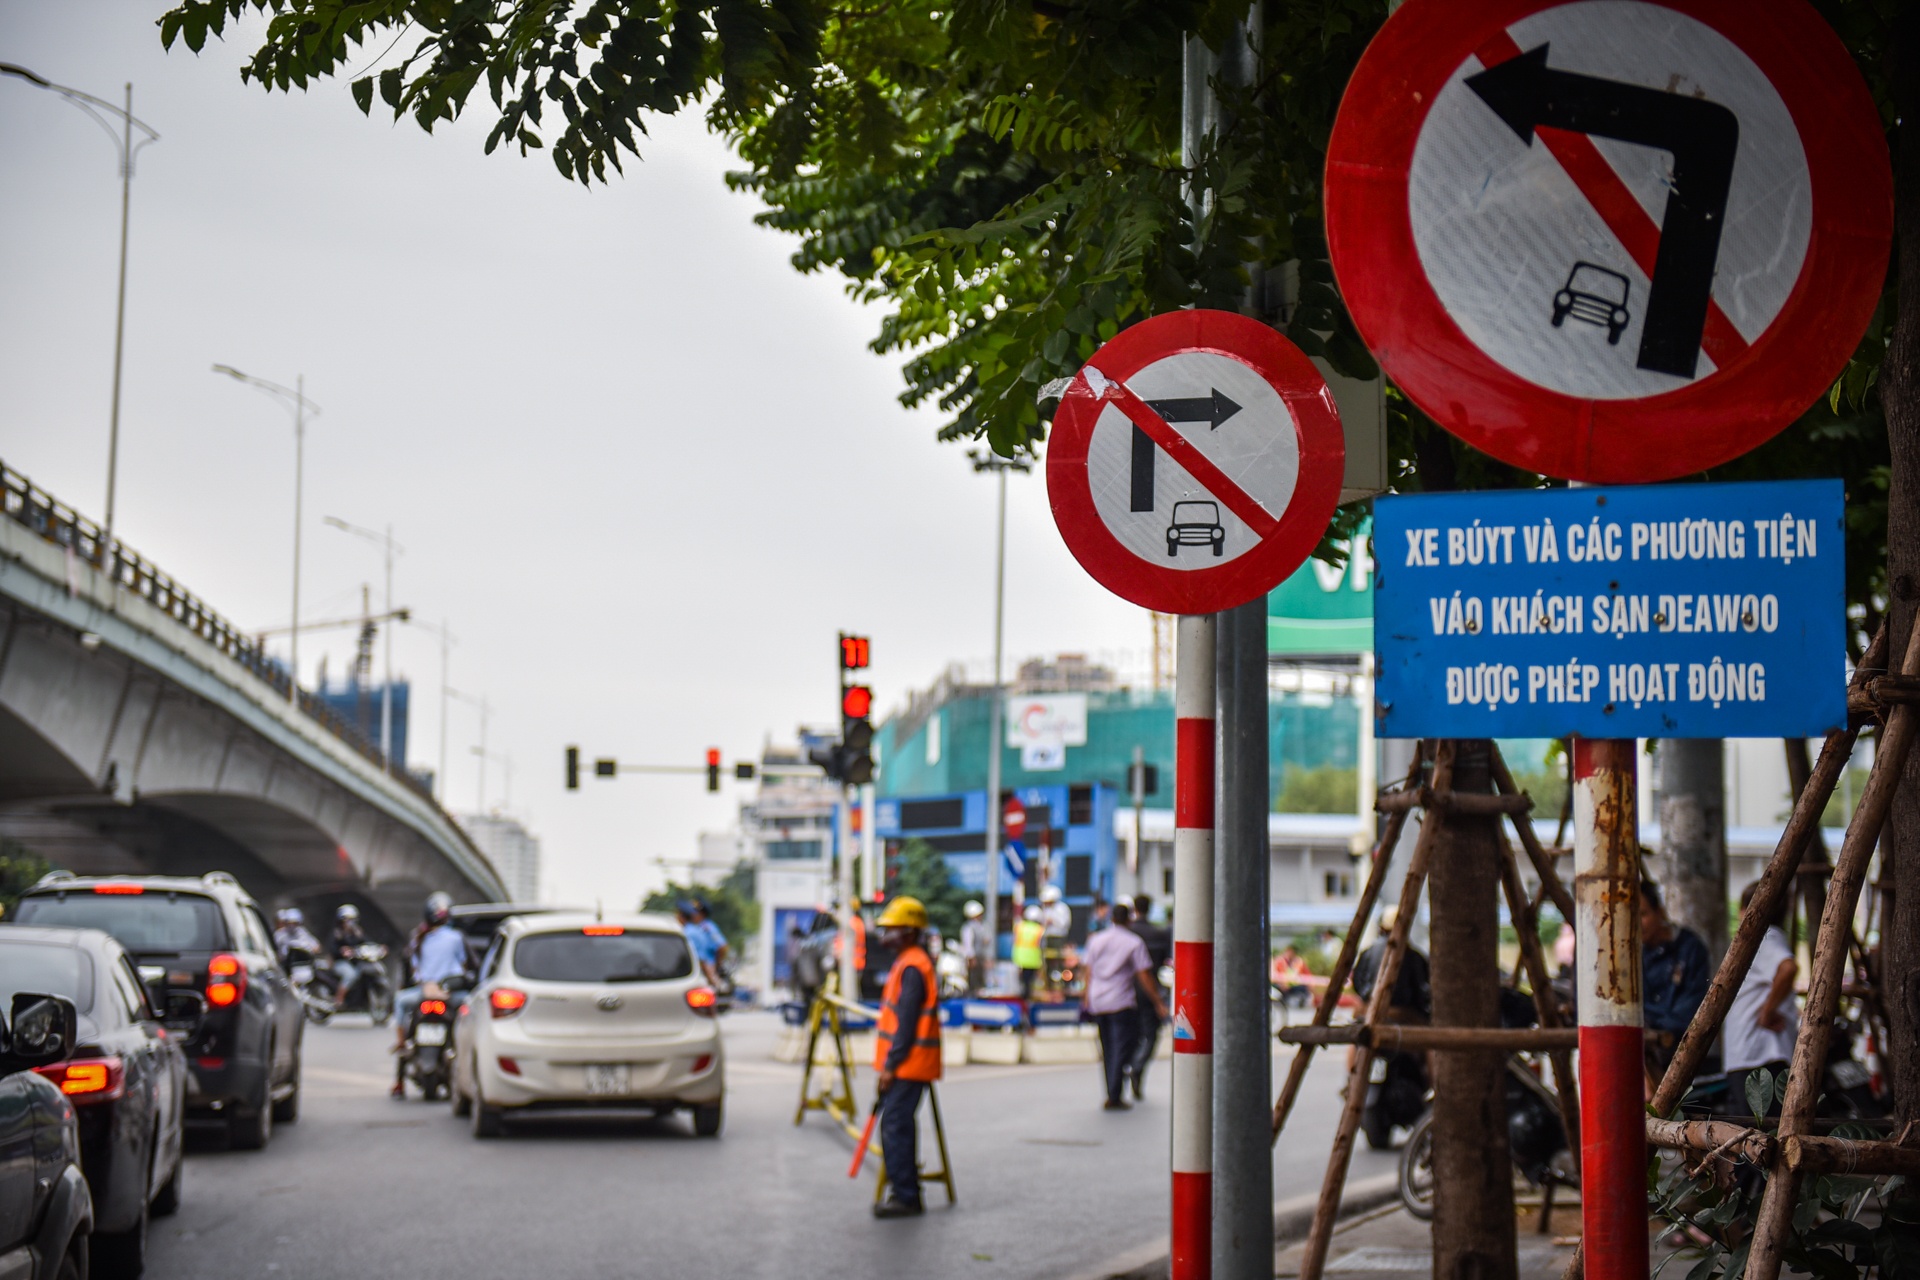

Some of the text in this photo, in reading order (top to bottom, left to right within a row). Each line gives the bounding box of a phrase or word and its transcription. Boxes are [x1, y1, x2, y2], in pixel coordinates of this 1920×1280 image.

[1405, 512, 1817, 567] XE BÚYT VÀ CÁC PHƯƠNG TIỆN
[1430, 588, 1779, 640] VÁO KHÁCH SẠN DEAWOO
[1446, 656, 1766, 711] ĐƯỢC PHÉP HỌAT ĐỘNG
